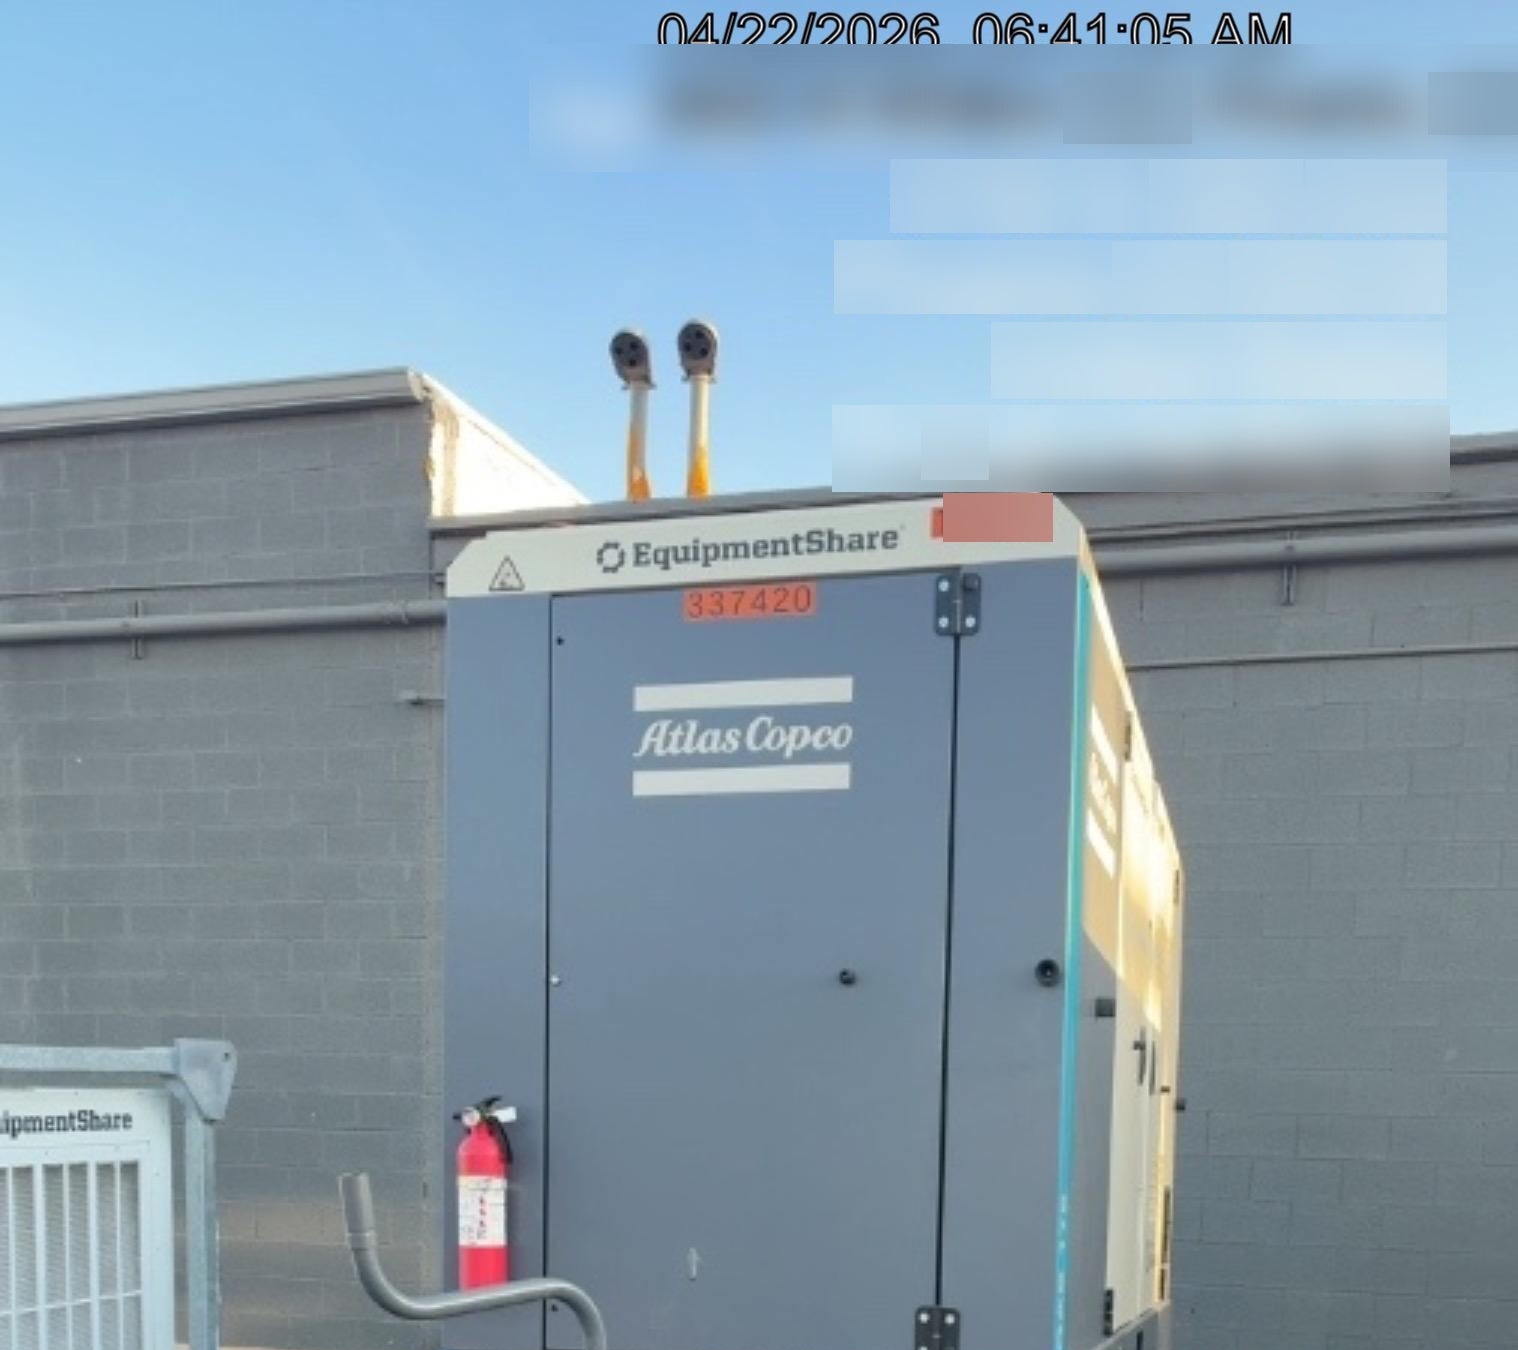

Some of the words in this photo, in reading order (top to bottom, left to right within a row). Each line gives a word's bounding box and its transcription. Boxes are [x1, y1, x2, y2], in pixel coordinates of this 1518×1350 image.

[632, 527, 899, 571] EquipmentShare
[686, 583, 813, 618] 337420
[632, 719, 742, 757] Atlas
[745, 715, 853, 759] Copco
